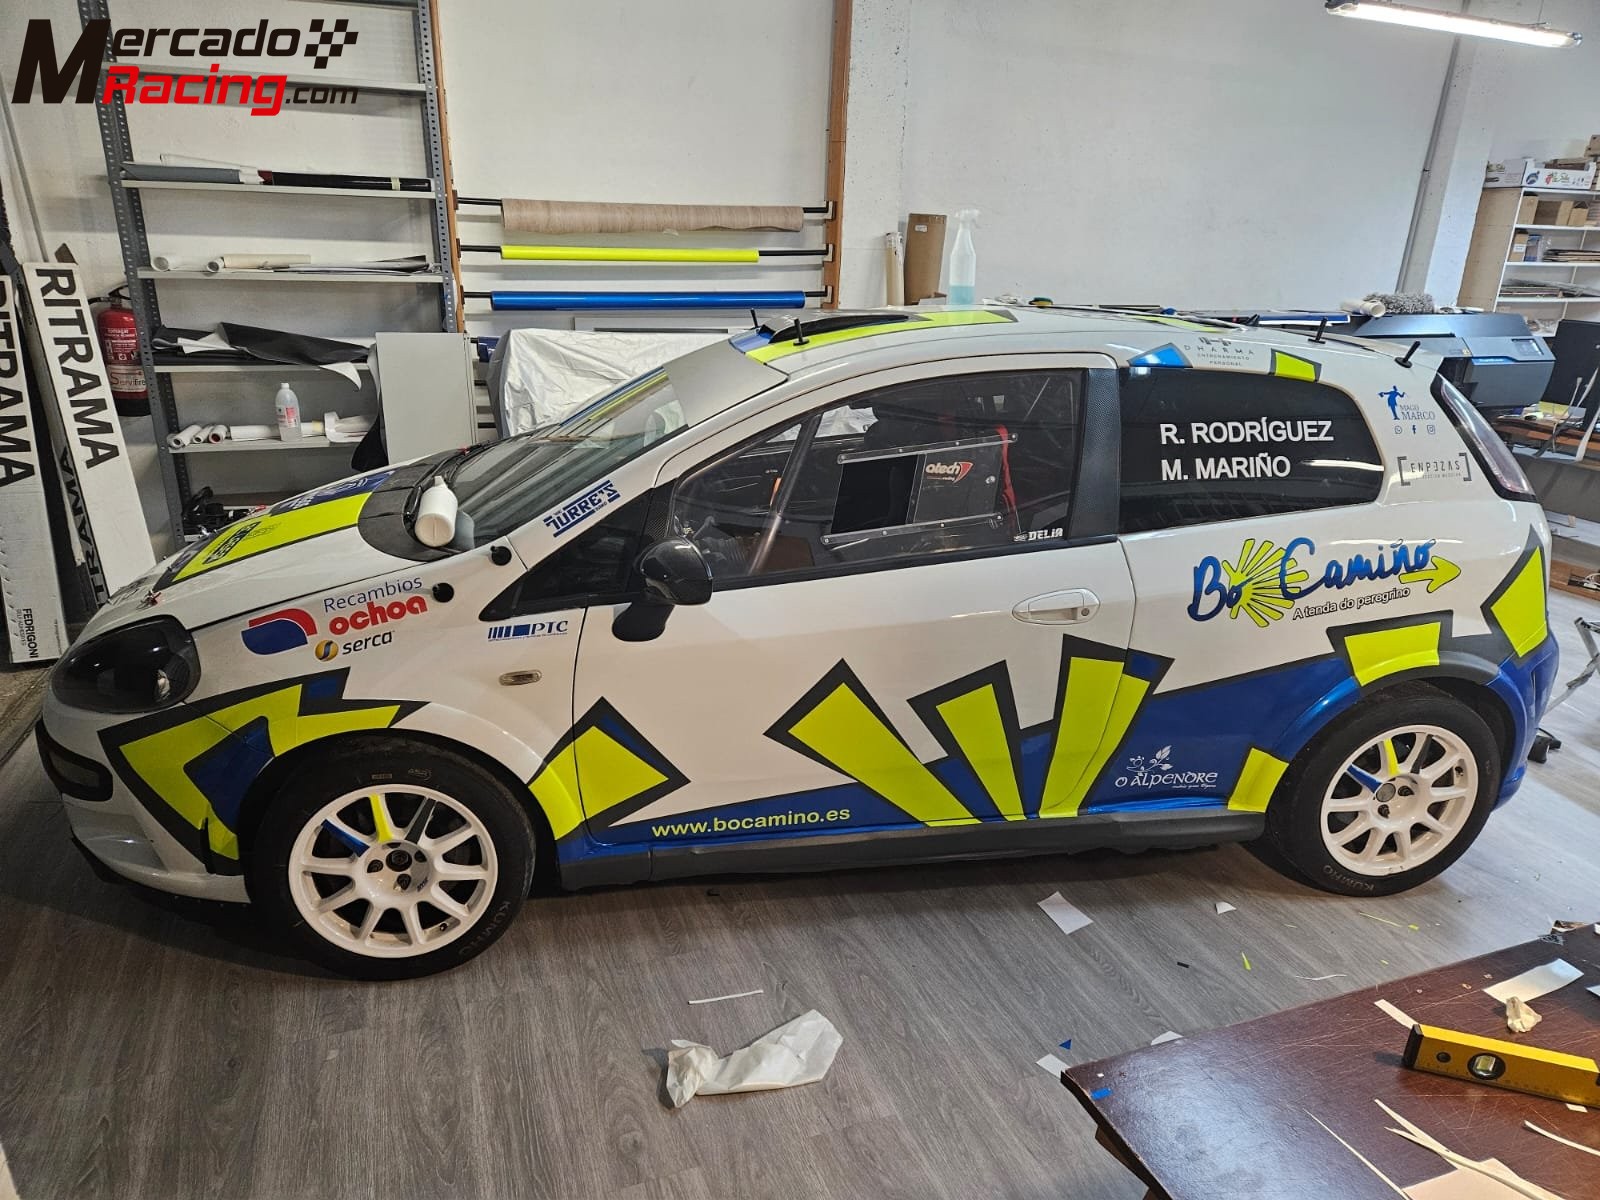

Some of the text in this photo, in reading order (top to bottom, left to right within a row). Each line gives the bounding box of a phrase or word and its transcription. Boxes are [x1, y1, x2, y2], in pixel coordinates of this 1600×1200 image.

[0, 280, 36, 487] TRAMA
[35, 268, 120, 470] RITRAMA
[1159, 416, 1334, 445] R. RODRÍGUEZ
[1401, 411, 1436, 421] MARCO
[1161, 452, 1291, 481] M. MARIÑO
[323, 577, 423, 613] Recambios
[1293, 587, 1411, 620] A tenda do peregrino
[328, 595, 429, 635] ochoa
[531, 620, 569, 635] PTC
[22, 607, 40, 659] FEDRIGONI
[341, 631, 393, 655] serca
[651, 809, 851, 837] www.bocamino.es
